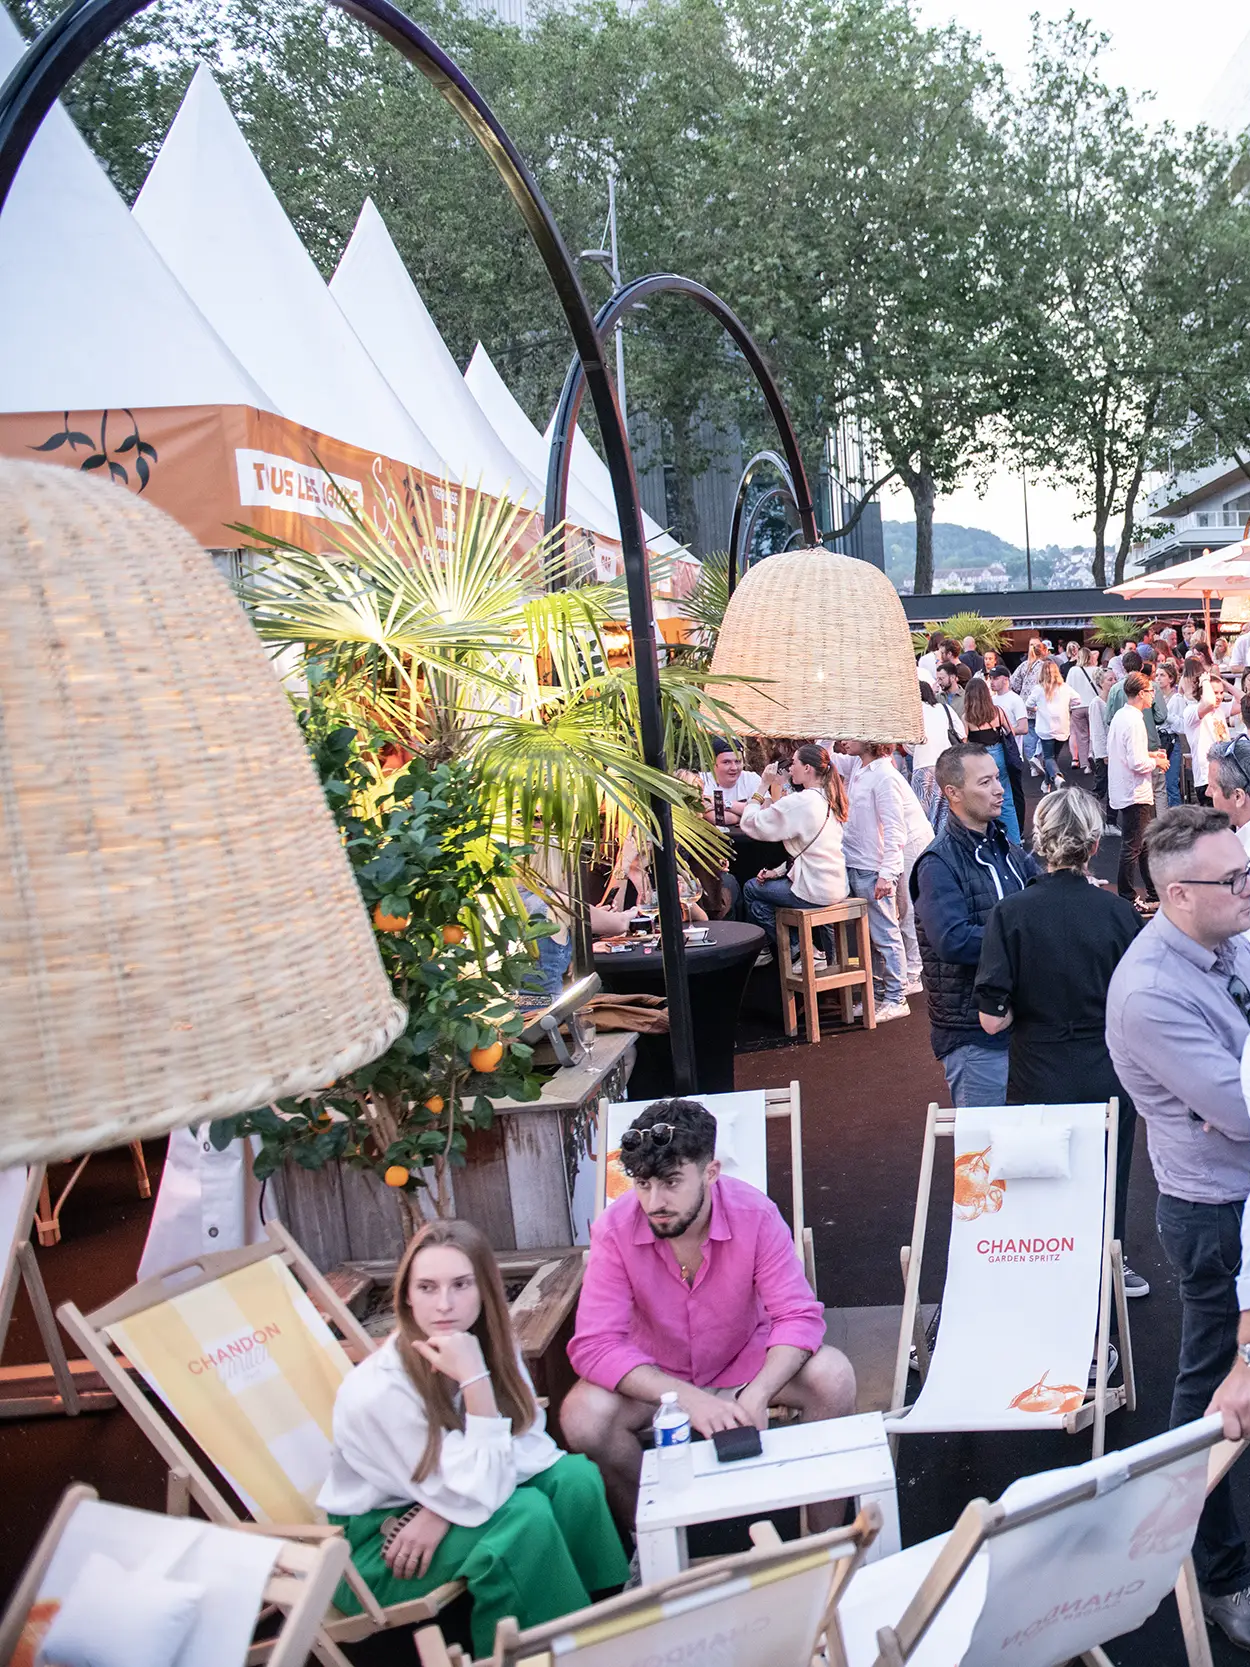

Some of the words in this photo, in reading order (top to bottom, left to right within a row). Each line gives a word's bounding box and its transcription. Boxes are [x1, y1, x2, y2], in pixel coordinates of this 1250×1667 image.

[253, 462, 294, 497] TUS
[976, 1237, 1074, 1255] CHANDON
[988, 1254, 1026, 1263] GARDEN
[1029, 1253, 1060, 1263] SPRITZ
[187, 1322, 282, 1375] CHANDON
